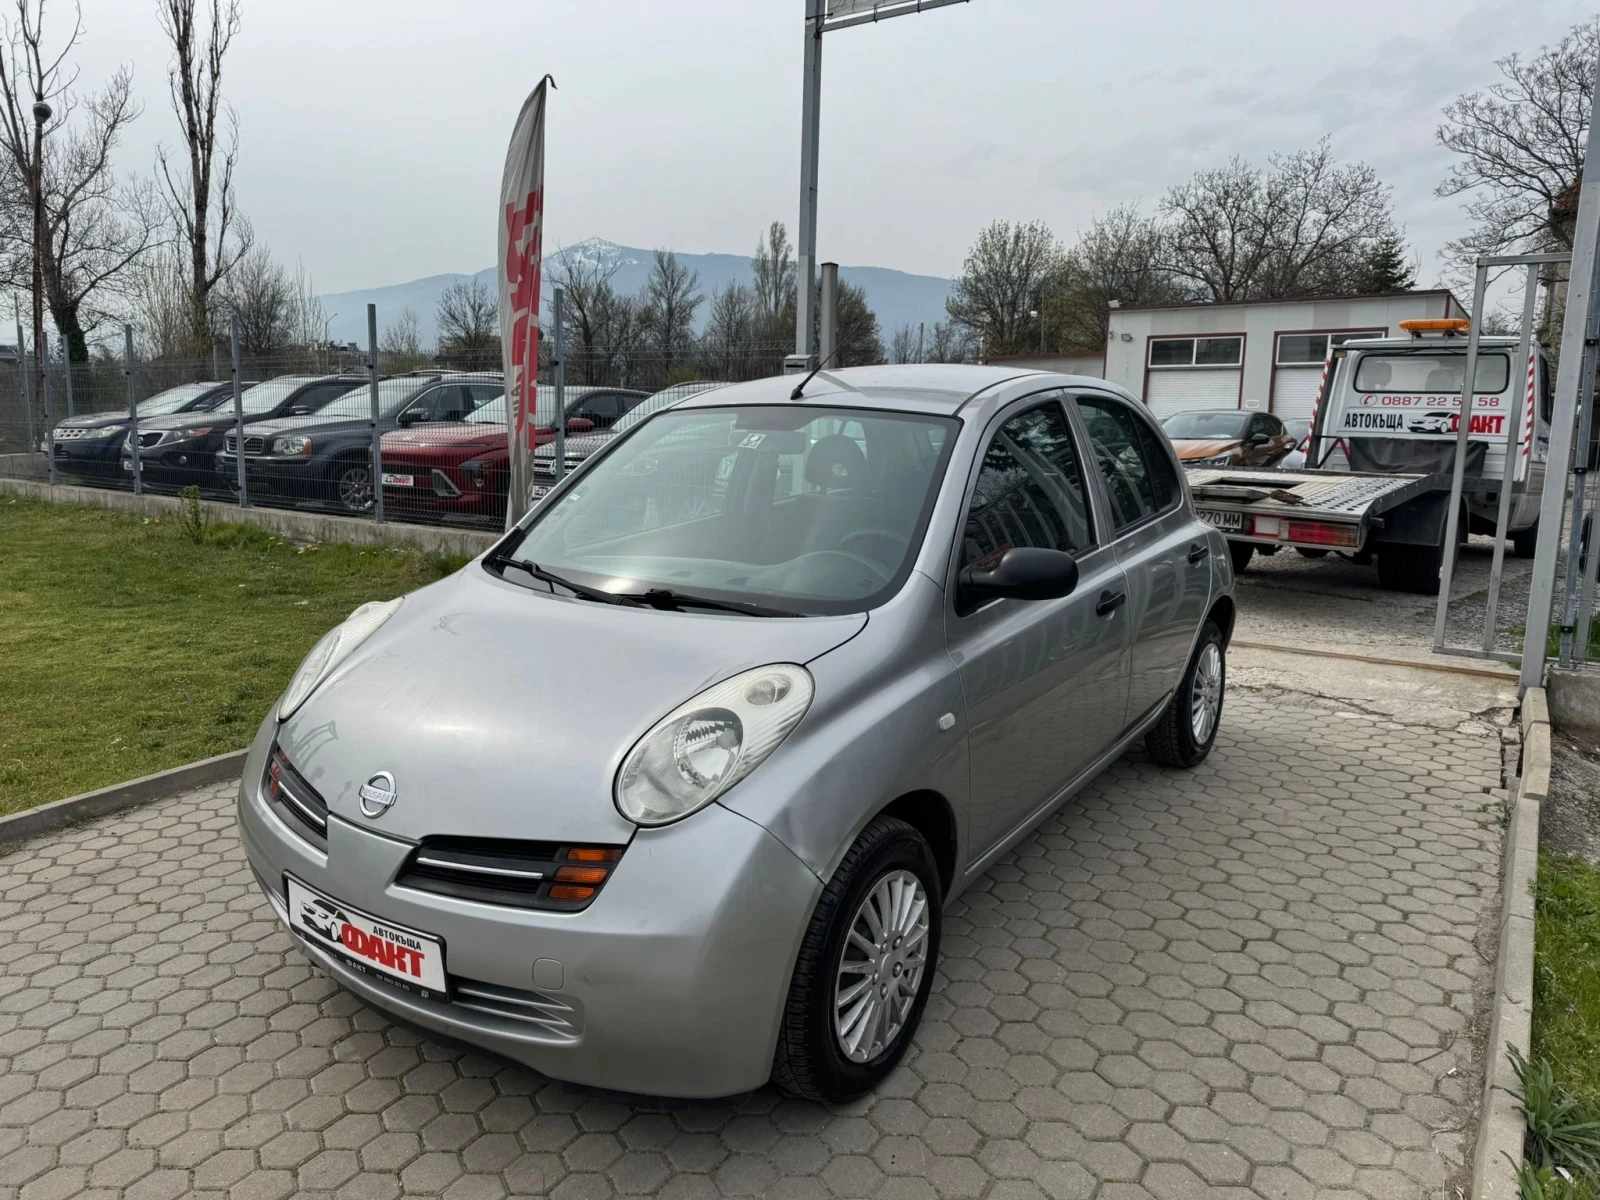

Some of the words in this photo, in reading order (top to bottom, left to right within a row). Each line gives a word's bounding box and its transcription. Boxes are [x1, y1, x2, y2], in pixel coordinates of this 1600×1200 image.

[1382, 396, 1422, 406] 0887
[1426, 397, 1446, 406] 22
[1478, 397, 1500, 407] 58
[1344, 412, 1403, 431] АВТОКЪЩА
[1196, 510, 1221, 525] 270
[373, 926, 421, 950] АВТОКЪЩА
[341, 923, 425, 978] ФАКТ
[346, 959, 367, 973] ФАКТ
